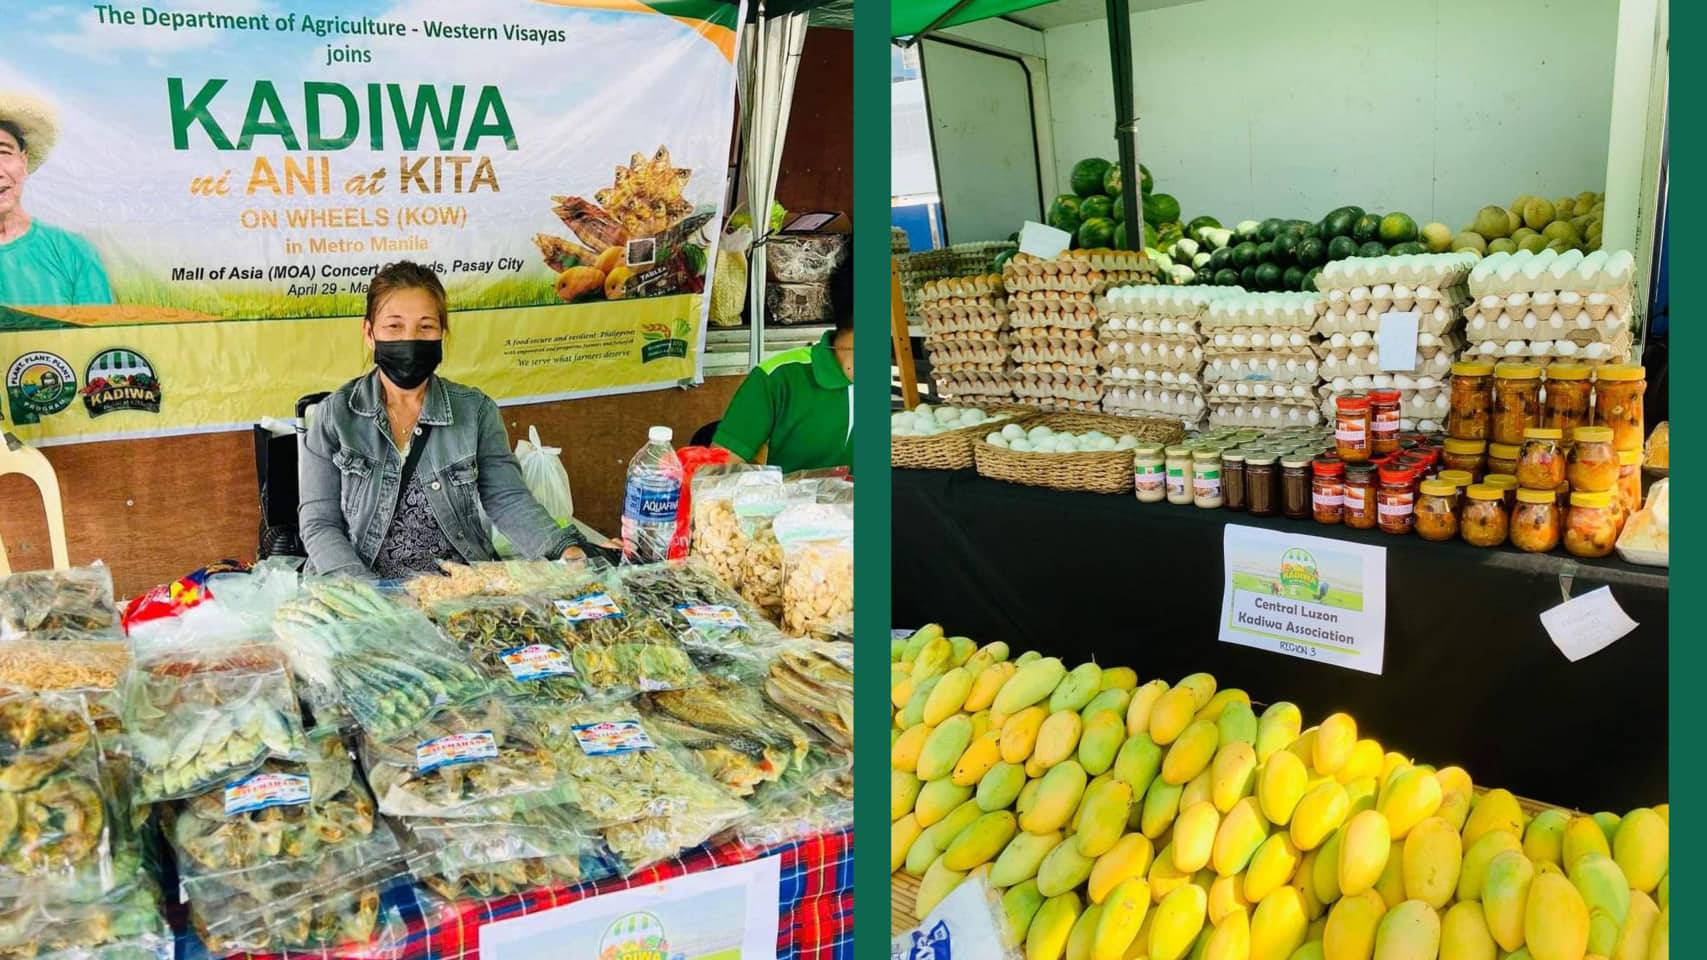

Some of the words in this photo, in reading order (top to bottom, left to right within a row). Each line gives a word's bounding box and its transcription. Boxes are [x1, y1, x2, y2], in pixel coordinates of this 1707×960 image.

[94, 5, 136, 25] The
[142, 7, 270, 31] Department
[275, 13, 296, 32] of
[301, 14, 406, 37] Agriculture
[423, 21, 498, 40] Western
[503, 24, 566, 45] Visayas
[326, 44, 372, 65] joins
[167, 77, 518, 151] KADIWA
[190, 169, 231, 196] ni
[246, 155, 331, 195] ANI
[343, 167, 388, 196] at
[399, 155, 501, 193] KITA
[239, 208, 278, 229] ON
[285, 207, 390, 229] WHEELS
[396, 205, 468, 231] (KOW)
[285, 238, 303, 254] in
[309, 238, 365, 254] Metro
[370, 234, 430, 252] Manila
[171, 267, 205, 281] Mall
[209, 267, 226, 280] of
[228, 266, 263, 280] Asia
[268, 264, 316, 282] (MOA)
[320, 262, 380, 278] Concert
[452, 259, 494, 274] Pasay
[497, 257, 525, 272] City
[287, 283, 318, 299] April
[321, 283, 337, 295] 29
[23, 398, 66, 411] PROGRAM
[90, 386, 156, 407] KADIWA
[1254, 596, 1298, 616] Central
[1301, 606, 1339, 623] Luzon
[1238, 611, 1283, 631] Kadiwa
[1286, 621, 1355, 645] Association
[1279, 641, 1308, 656] REGION
[1310, 647, 1317, 656] 3
